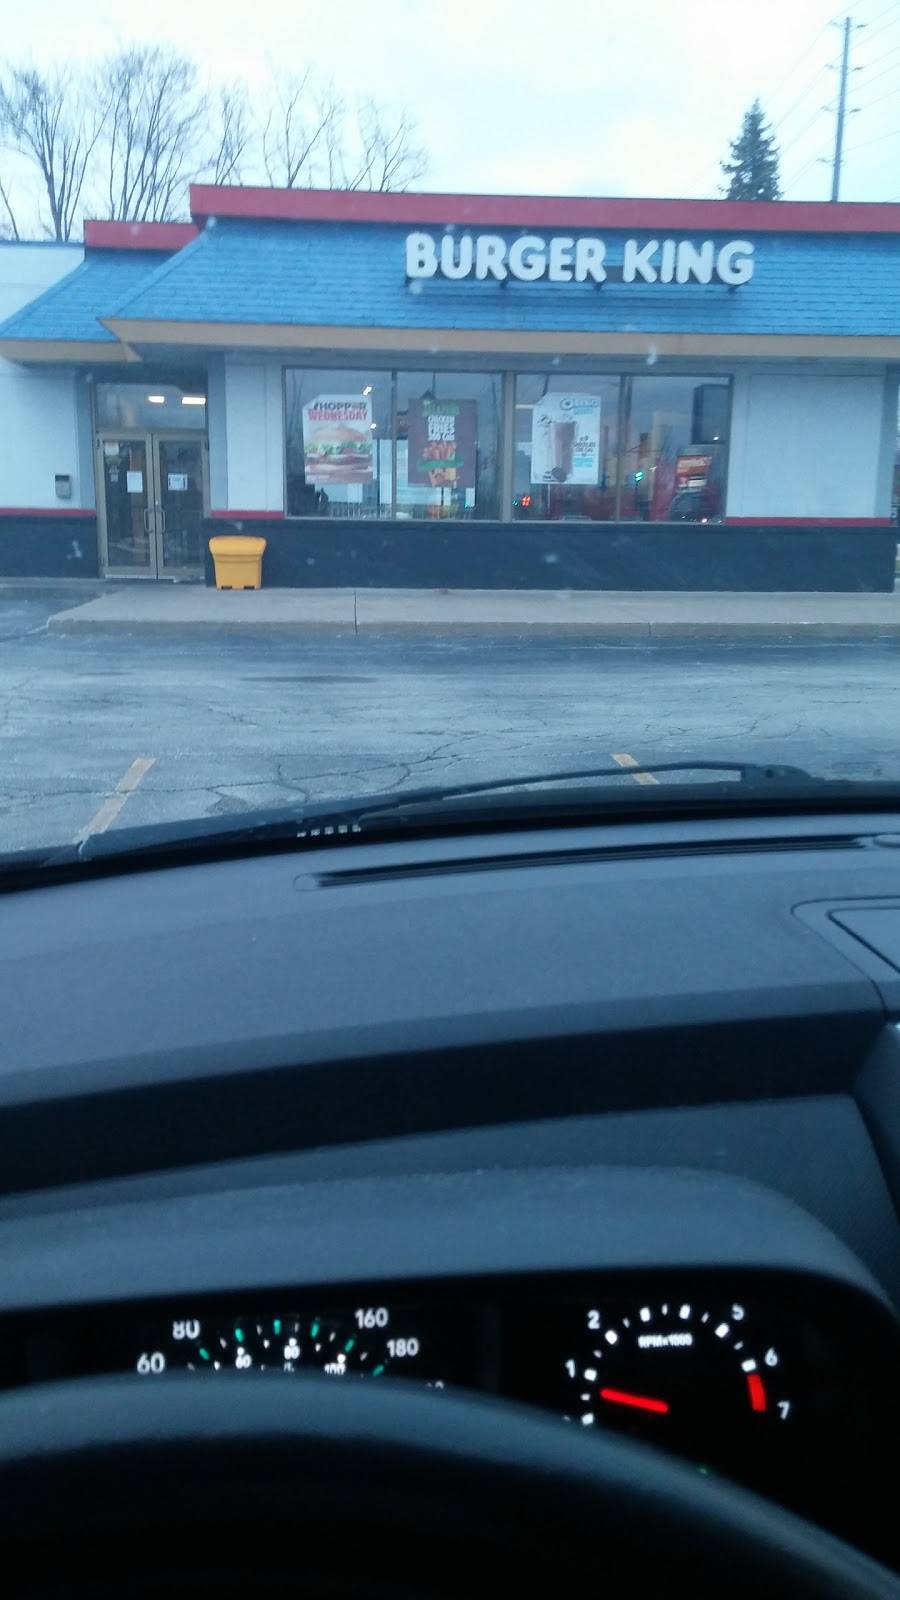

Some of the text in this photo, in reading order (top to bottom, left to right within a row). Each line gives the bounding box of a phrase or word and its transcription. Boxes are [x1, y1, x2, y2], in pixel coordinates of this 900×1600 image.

[405, 232, 755, 285] BURGER KING
[308, 409, 368, 421] WEDNESDAY
[355, 1307, 390, 1329] 160
[587, 1309, 601, 1330] 2
[731, 1304, 746, 1322] 5
[386, 1337, 420, 1358] 180
[764, 1346, 779, 1367] 6
[136, 1352, 166, 1375] 60
[565, 1359, 576, 1379] 1
[777, 1400, 790, 1420] 7
